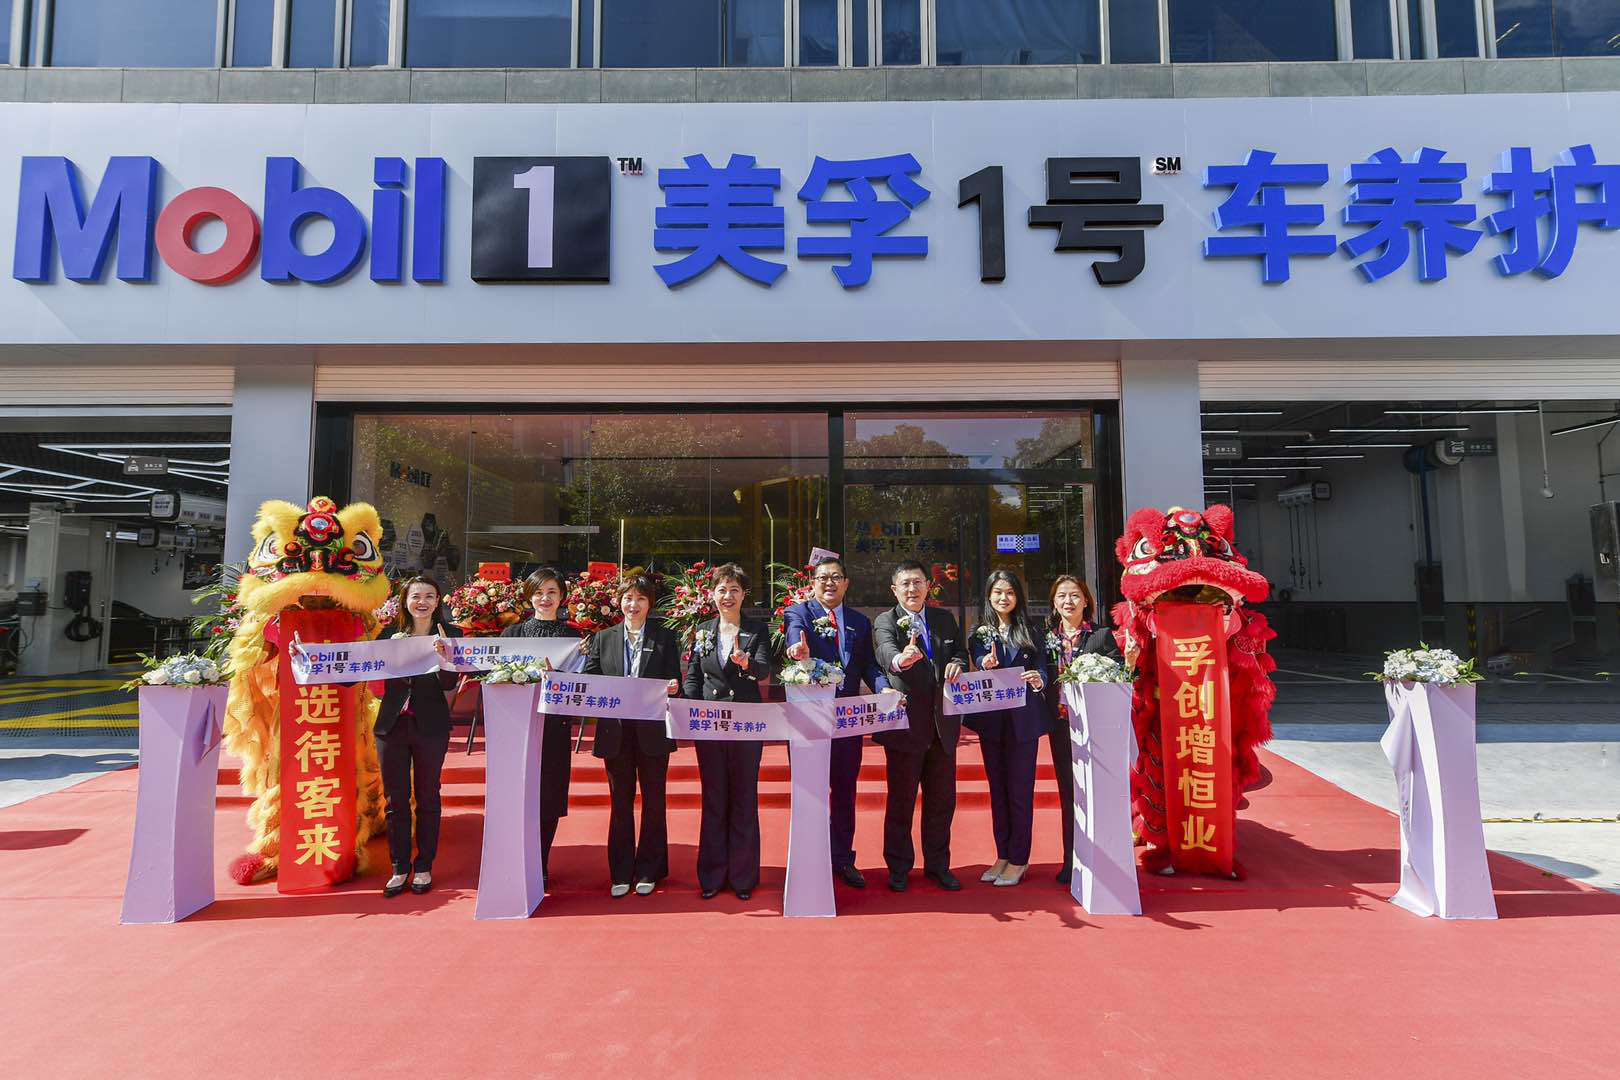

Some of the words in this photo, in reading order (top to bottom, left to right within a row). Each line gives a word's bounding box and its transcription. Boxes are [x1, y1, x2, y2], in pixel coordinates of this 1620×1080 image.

[1155, 156, 1182, 171] SM
[13, 155, 447, 286] Mobil
[616, 157, 643, 172] TM
[453, 645, 488, 655] Mobil
[951, 680, 982, 693] Mobil
[689, 708, 720, 719] Mobil
[836, 703, 866, 716] Mobil
[1171, 634, 1217, 852] 孚创增恒业
[294, 640, 342, 866] 选待客来
